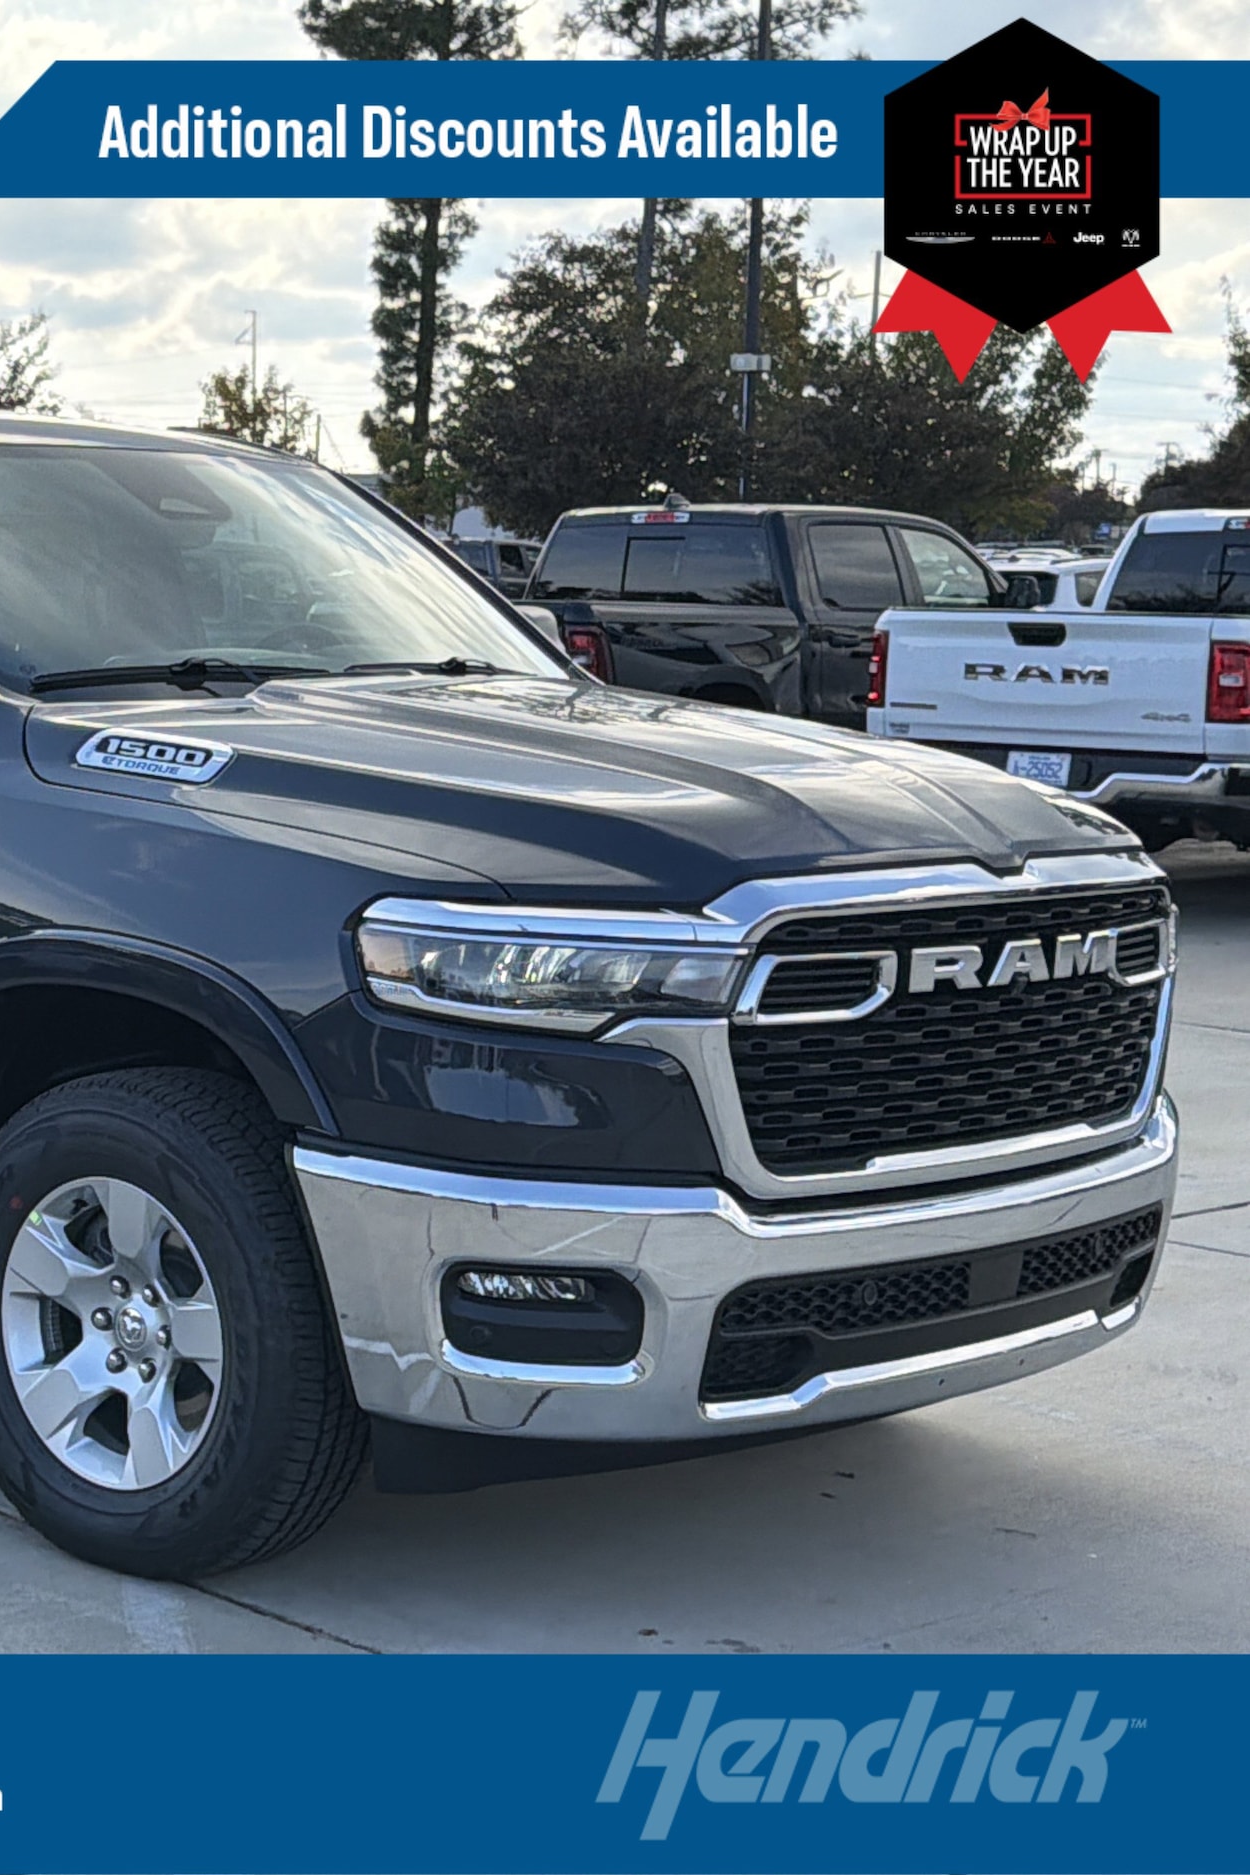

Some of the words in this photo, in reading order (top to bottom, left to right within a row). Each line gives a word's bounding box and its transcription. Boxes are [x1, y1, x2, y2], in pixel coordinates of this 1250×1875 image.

[964, 662, 1110, 686] RAM
[107, 738, 207, 766] 1500
[908, 933, 1117, 994] RAM
